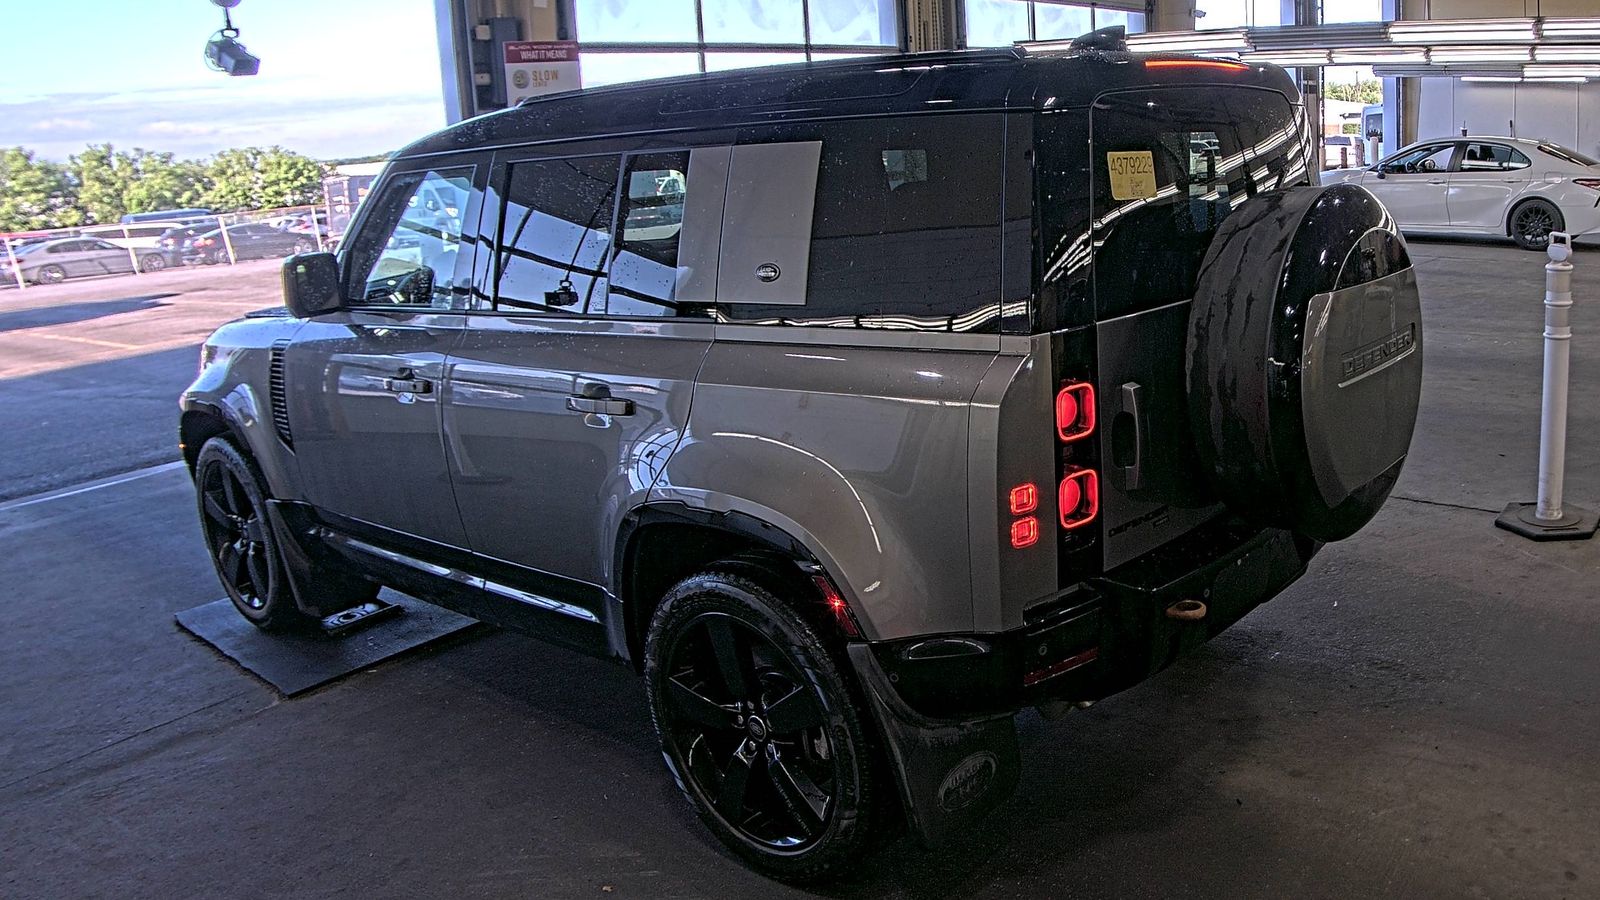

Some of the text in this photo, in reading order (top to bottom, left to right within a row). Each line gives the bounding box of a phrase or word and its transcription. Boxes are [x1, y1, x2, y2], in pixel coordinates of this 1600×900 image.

[520, 49, 568, 60] WHAT IT MEANS
[531, 69, 559, 81] SLOW
[1341, 330, 1412, 377] DEFENDER
